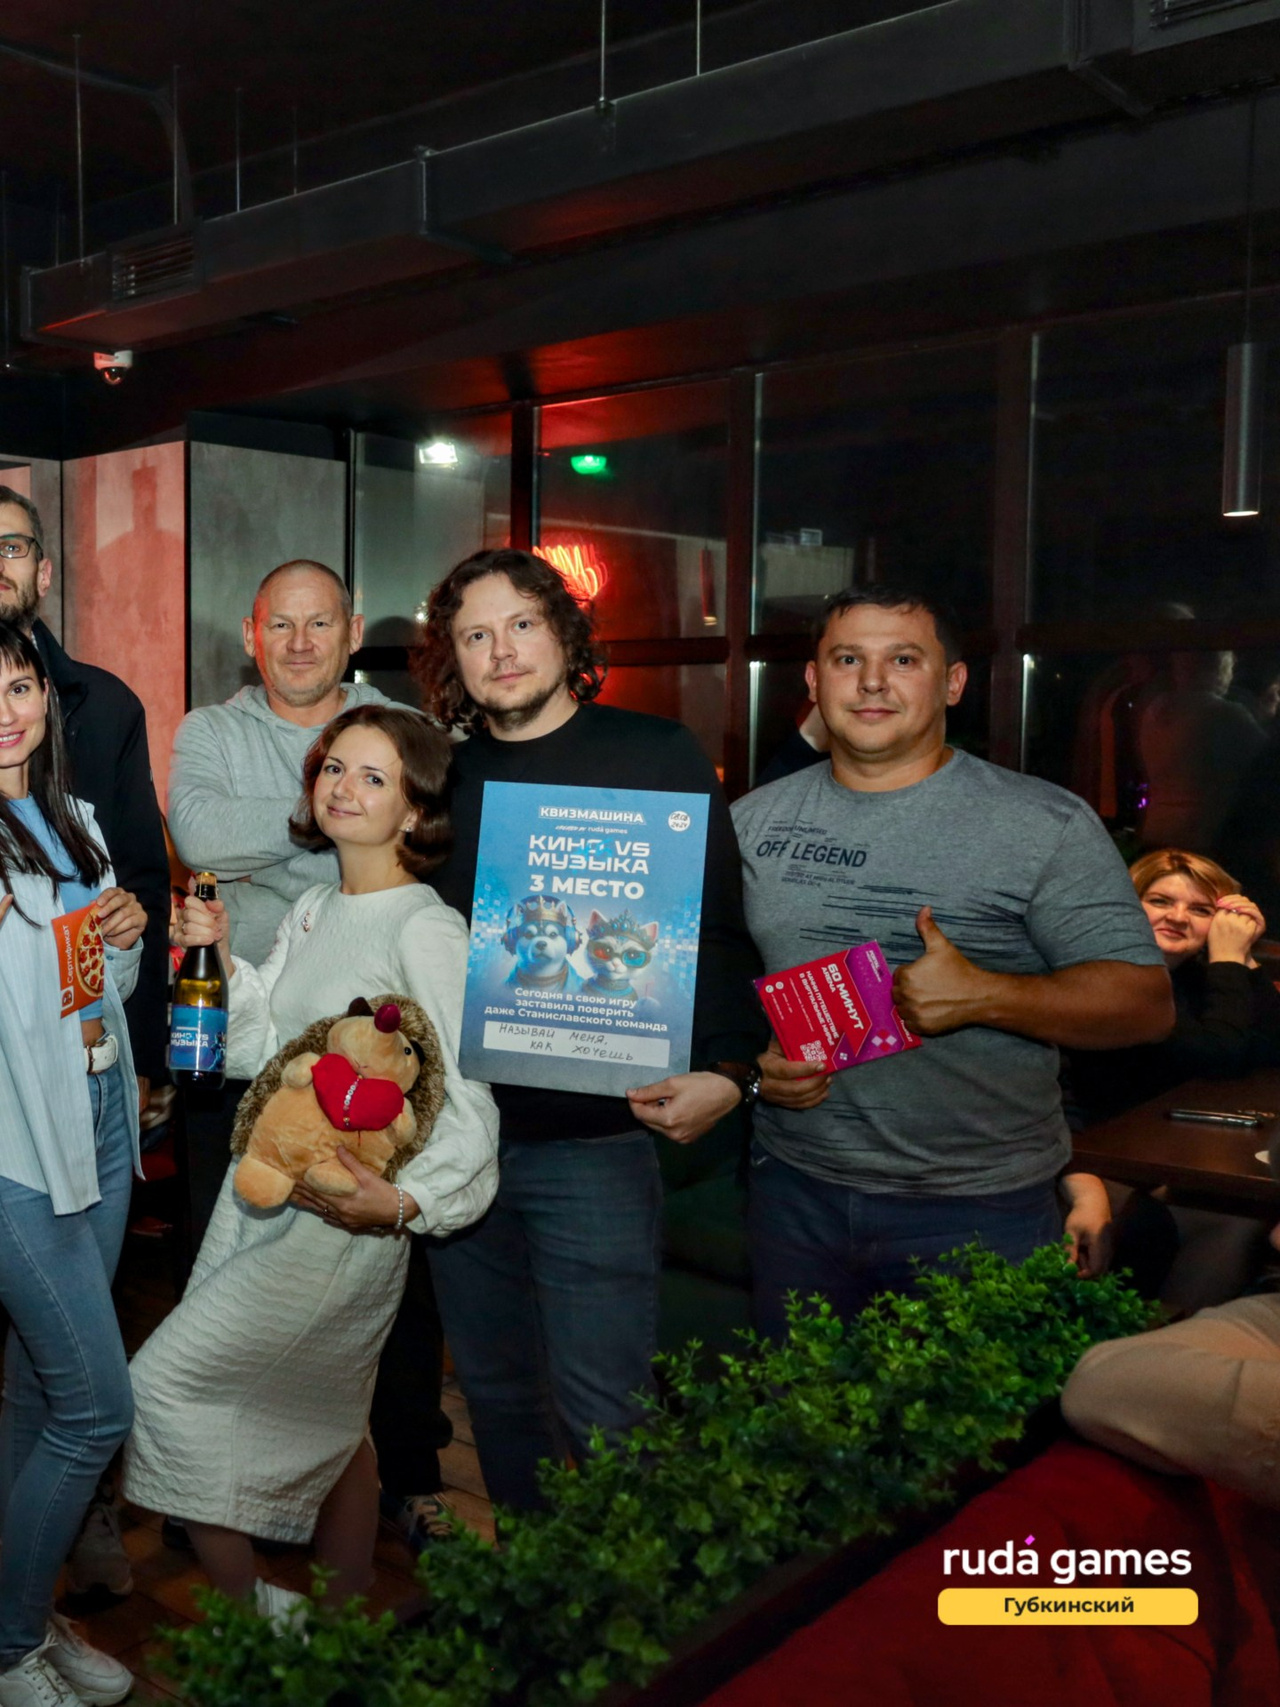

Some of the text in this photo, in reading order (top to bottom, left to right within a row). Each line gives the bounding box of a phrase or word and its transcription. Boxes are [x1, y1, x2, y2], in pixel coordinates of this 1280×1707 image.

[540, 807, 644, 823] КВИЗМАШИНА
[529, 834, 650, 857] КИНО VS
[756, 840, 867, 868] OFF LEGEND
[528, 852, 649, 875] МУЗЫКА
[529, 874, 644, 900] 3 МЕСТО
[62, 924, 74, 984] Сертификат
[514, 987, 563, 1001] Сегодня
[575, 994, 606, 1005] свою
[608, 998, 637, 1009] игру
[515, 998, 634, 1018] заставила поверить
[836, 983, 864, 1030] МИНУТ
[484, 1005, 667, 1032] даже Станиславского команда
[530, 1040, 553, 1051] КАК
